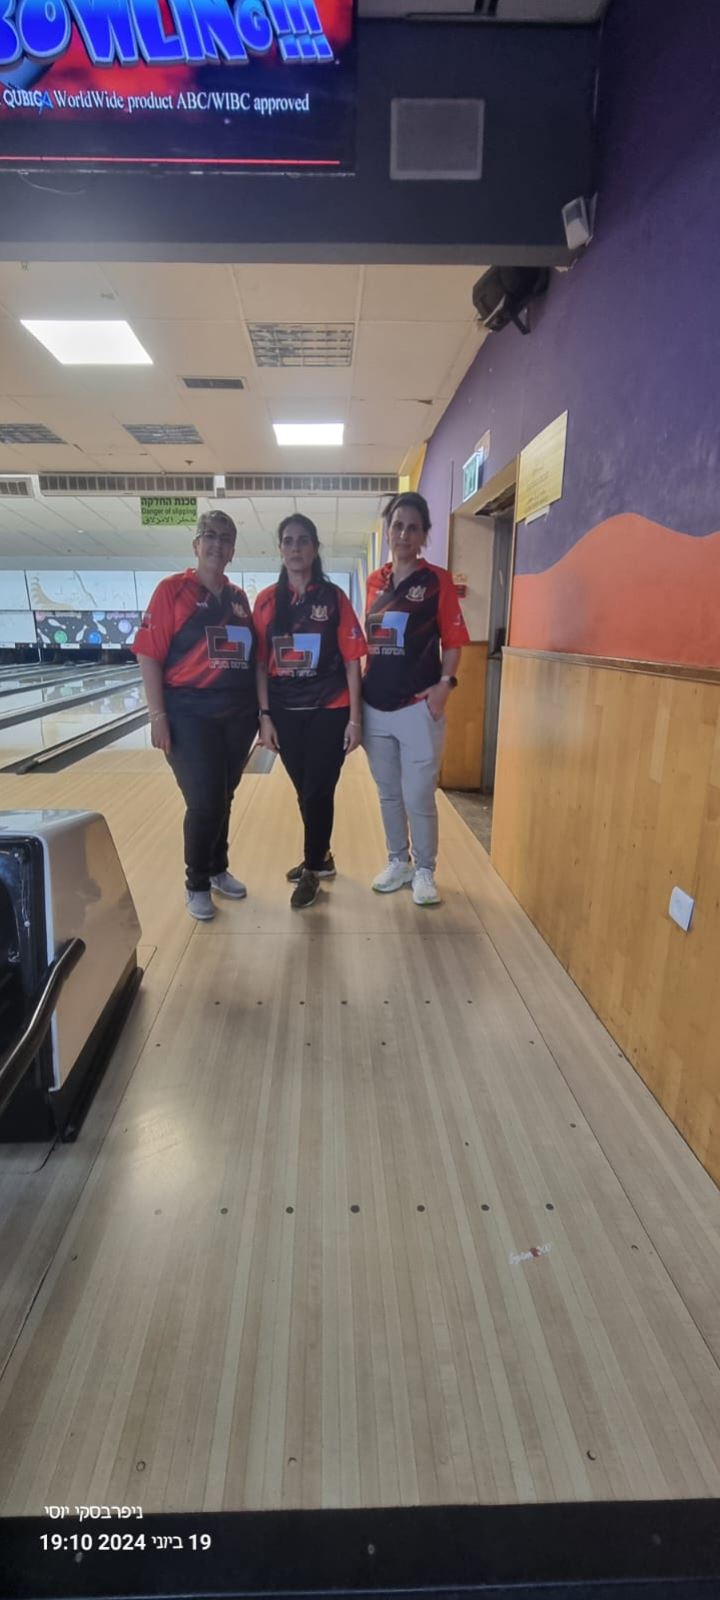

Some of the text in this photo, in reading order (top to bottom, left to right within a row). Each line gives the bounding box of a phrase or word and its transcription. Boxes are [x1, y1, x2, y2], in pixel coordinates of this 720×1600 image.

[54, 90, 124, 110] WorldWide
[128, 92, 173, 112] product
[177, 92, 250, 111] ABC/WIBC
[253, 94, 310, 113] approved
[141, 497, 197, 507] סכנת החלקה
[142, 508, 163, 516] Danger
[172, 508, 197, 516] slipping
